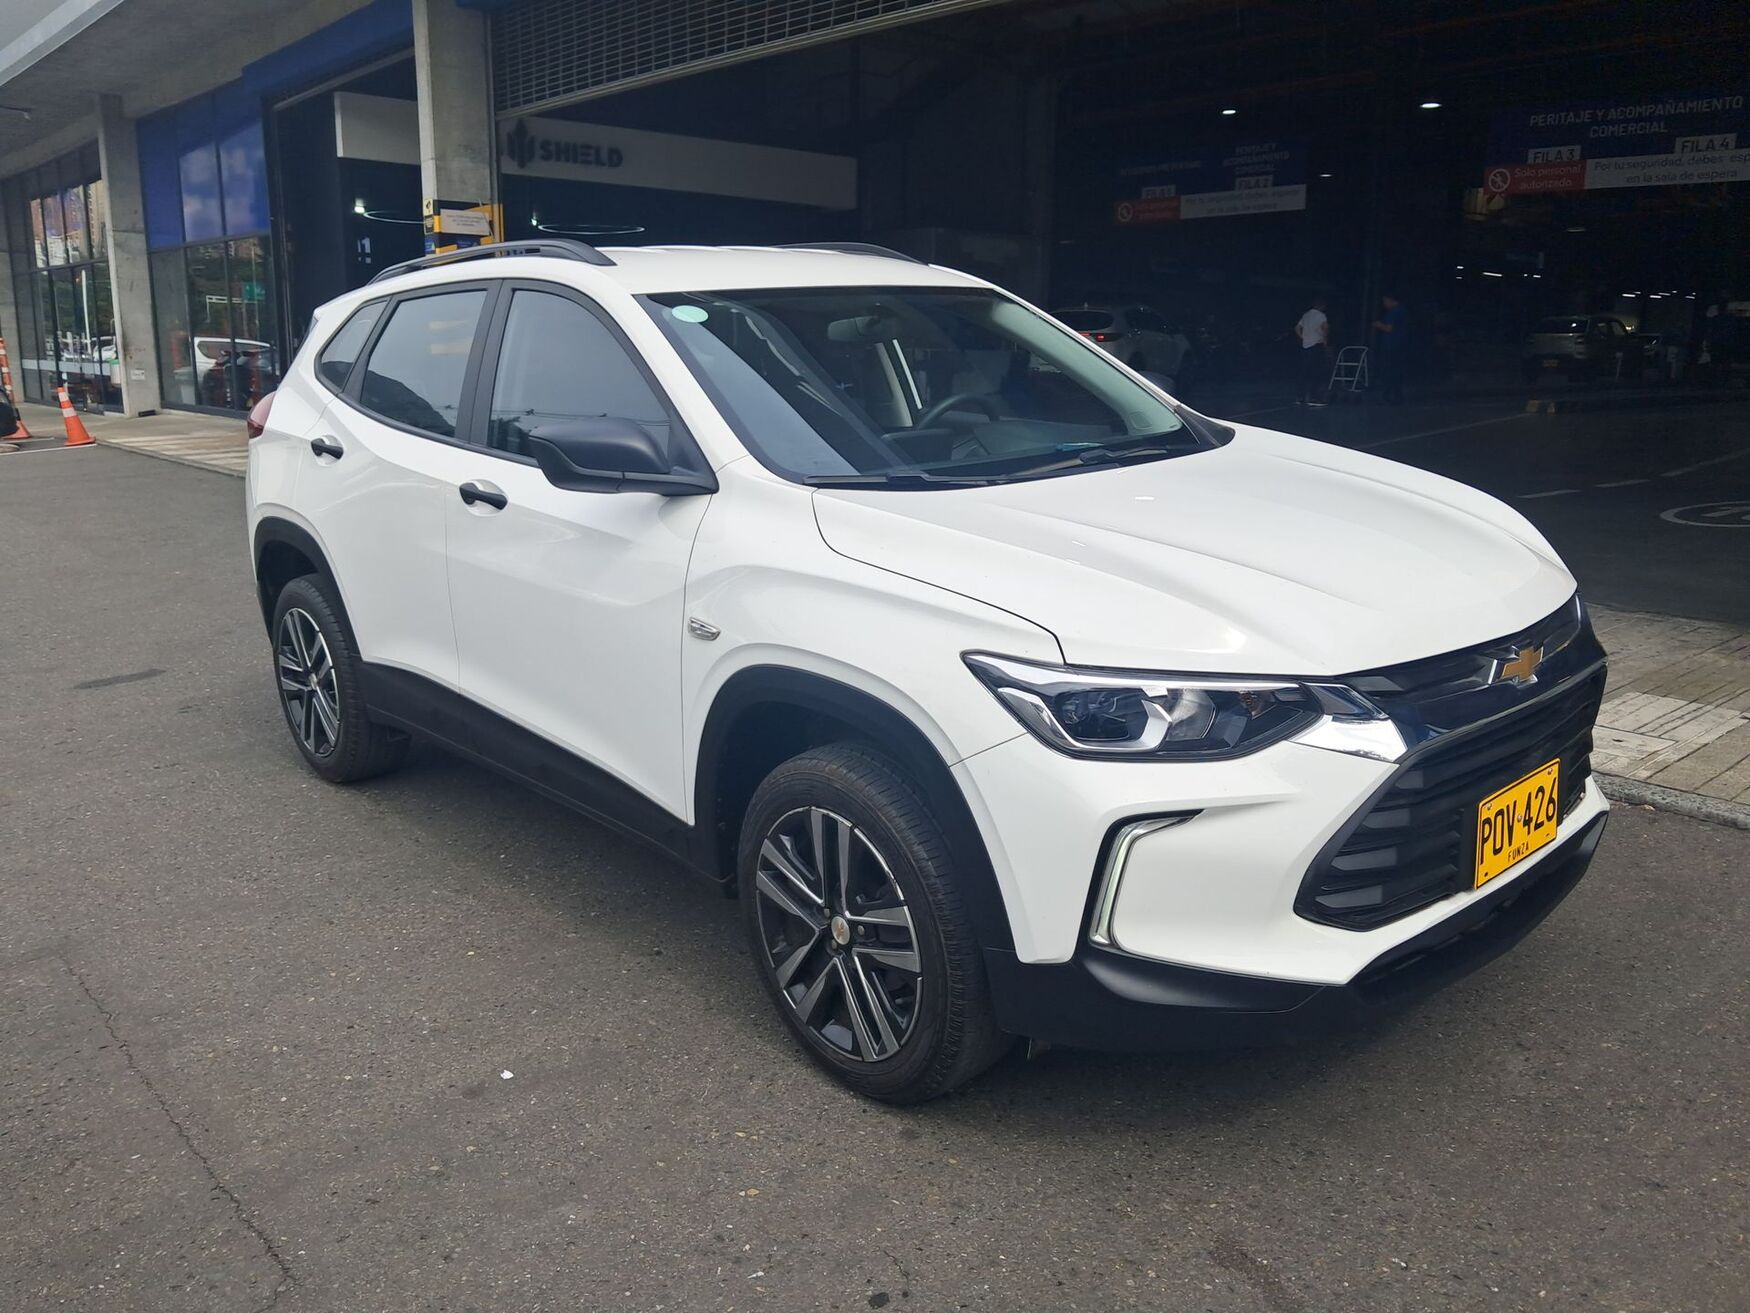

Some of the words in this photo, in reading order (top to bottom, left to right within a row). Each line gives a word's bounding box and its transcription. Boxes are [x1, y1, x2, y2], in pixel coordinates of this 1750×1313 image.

[1529, 110, 1593, 127] PERITAJE
[1595, 108, 1605, 121] Y
[1606, 95, 1744, 120] ACOMPAÑAMIENTO
[1590, 121, 1669, 138] COMERCIAL
[540, 140, 623, 167] SHIELD
[1533, 150, 1563, 163] FILA
[1566, 148, 1575, 161] 3
[1681, 139, 1715, 154] FILA
[1719, 137, 1729, 151] 4
[1480, 799, 1518, 865] POV
[1522, 777, 1557, 836] 426
[1507, 841, 1530, 863] FUNZA
